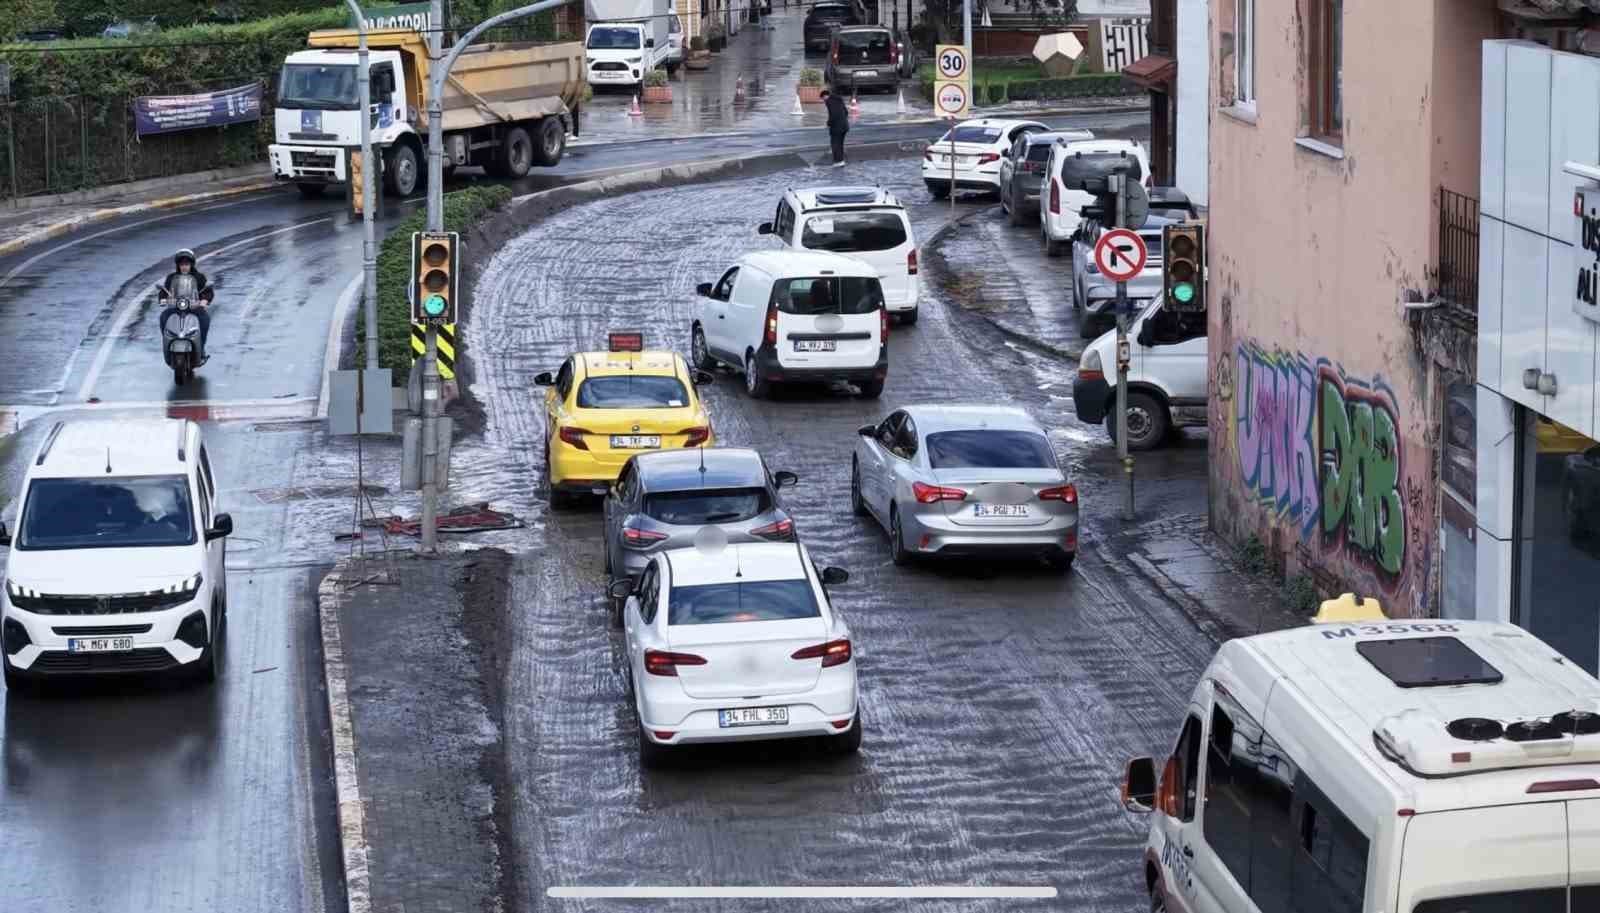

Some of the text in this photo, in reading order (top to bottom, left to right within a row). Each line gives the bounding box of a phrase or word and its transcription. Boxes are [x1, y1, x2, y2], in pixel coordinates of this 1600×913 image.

[942, 55, 962, 71] 30
[980, 504, 990, 515] 34
[1320, 623, 1460, 640] M3568
[75, 640, 86, 650] 34
[726, 707, 786, 722] 34 FHL 350
